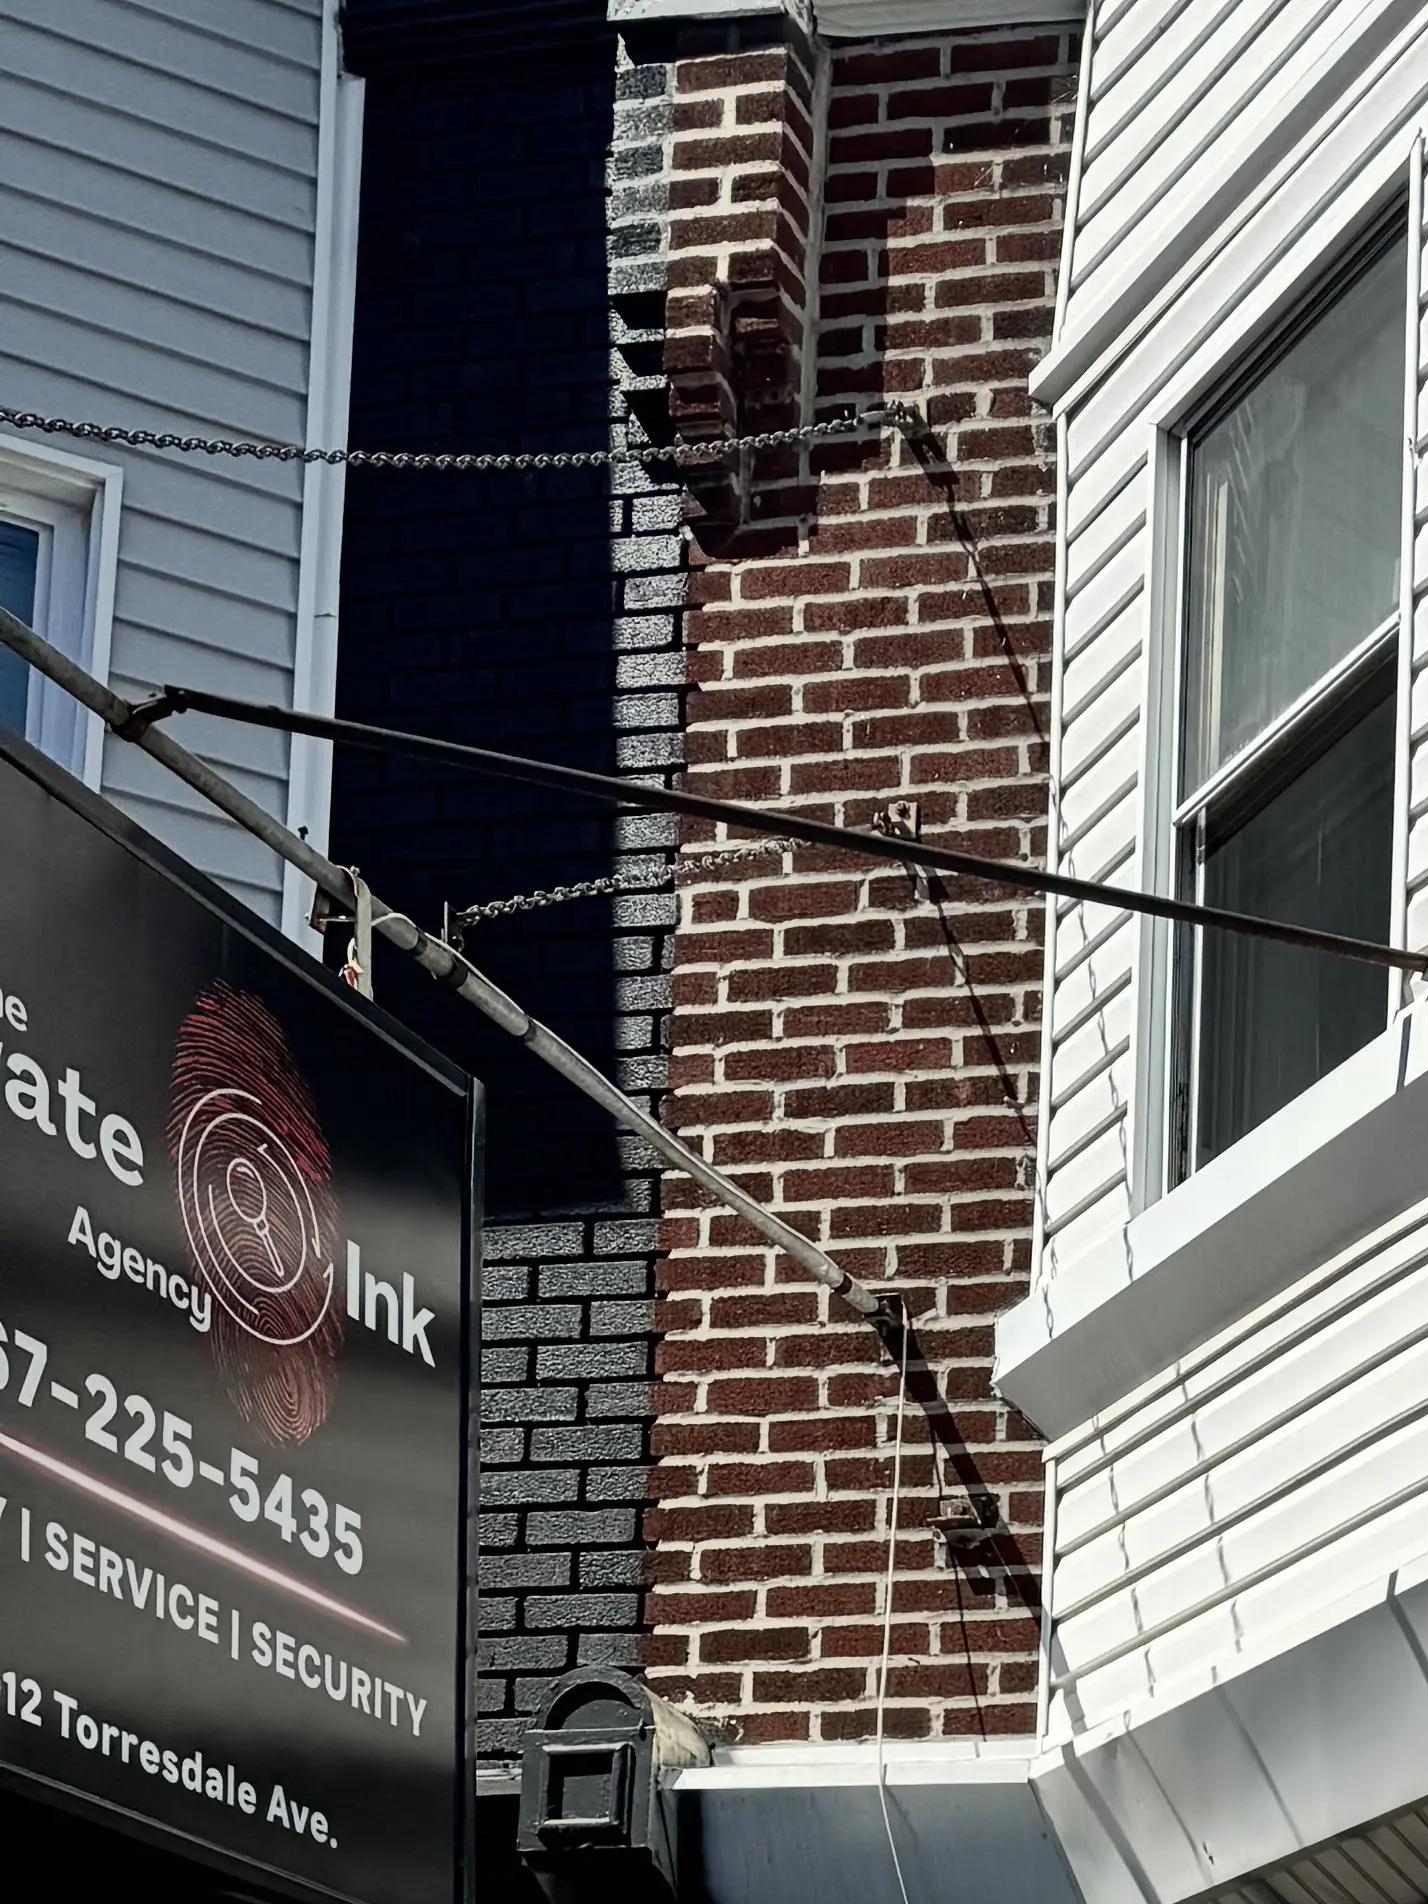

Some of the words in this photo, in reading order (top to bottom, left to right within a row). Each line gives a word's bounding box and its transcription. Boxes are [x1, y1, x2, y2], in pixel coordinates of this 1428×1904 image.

[0, 1042, 144, 1186] ate
[67, 1206, 212, 1332] Agency
[345, 1240, 436, 1368] Ink
[45, 1521, 219, 1644] SERVICE
[252, 1621, 427, 1738] SECURITY
[53, 1691, 257, 1815] Torresdale
[267, 1784, 339, 1850] Ave.
